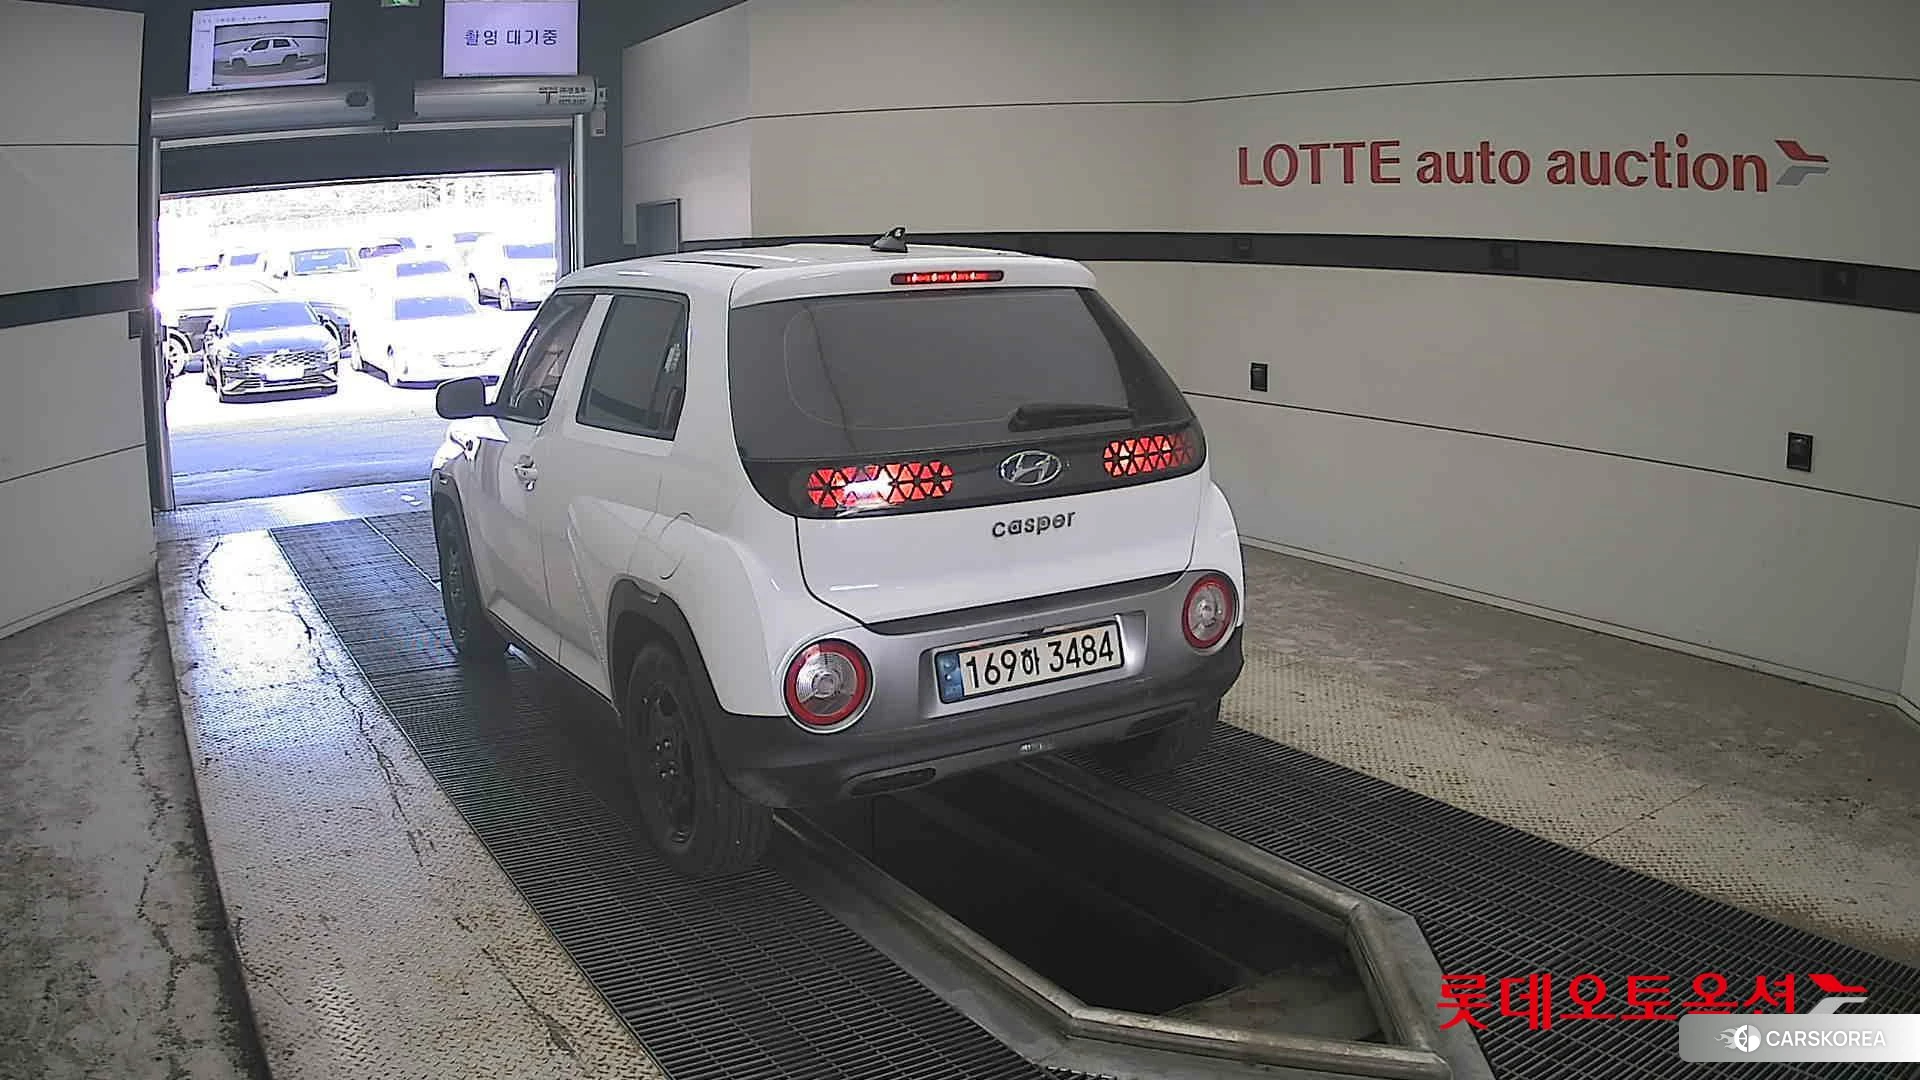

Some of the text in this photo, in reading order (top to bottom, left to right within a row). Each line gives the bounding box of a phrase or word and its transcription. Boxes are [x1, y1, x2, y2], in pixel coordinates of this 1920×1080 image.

[464, 29, 558, 47] 촬영 대기중
[1237, 133, 1768, 193] LOTTE auto auction
[991, 511, 1076, 538] casper
[966, 630, 1114, 689] 169하 3484
